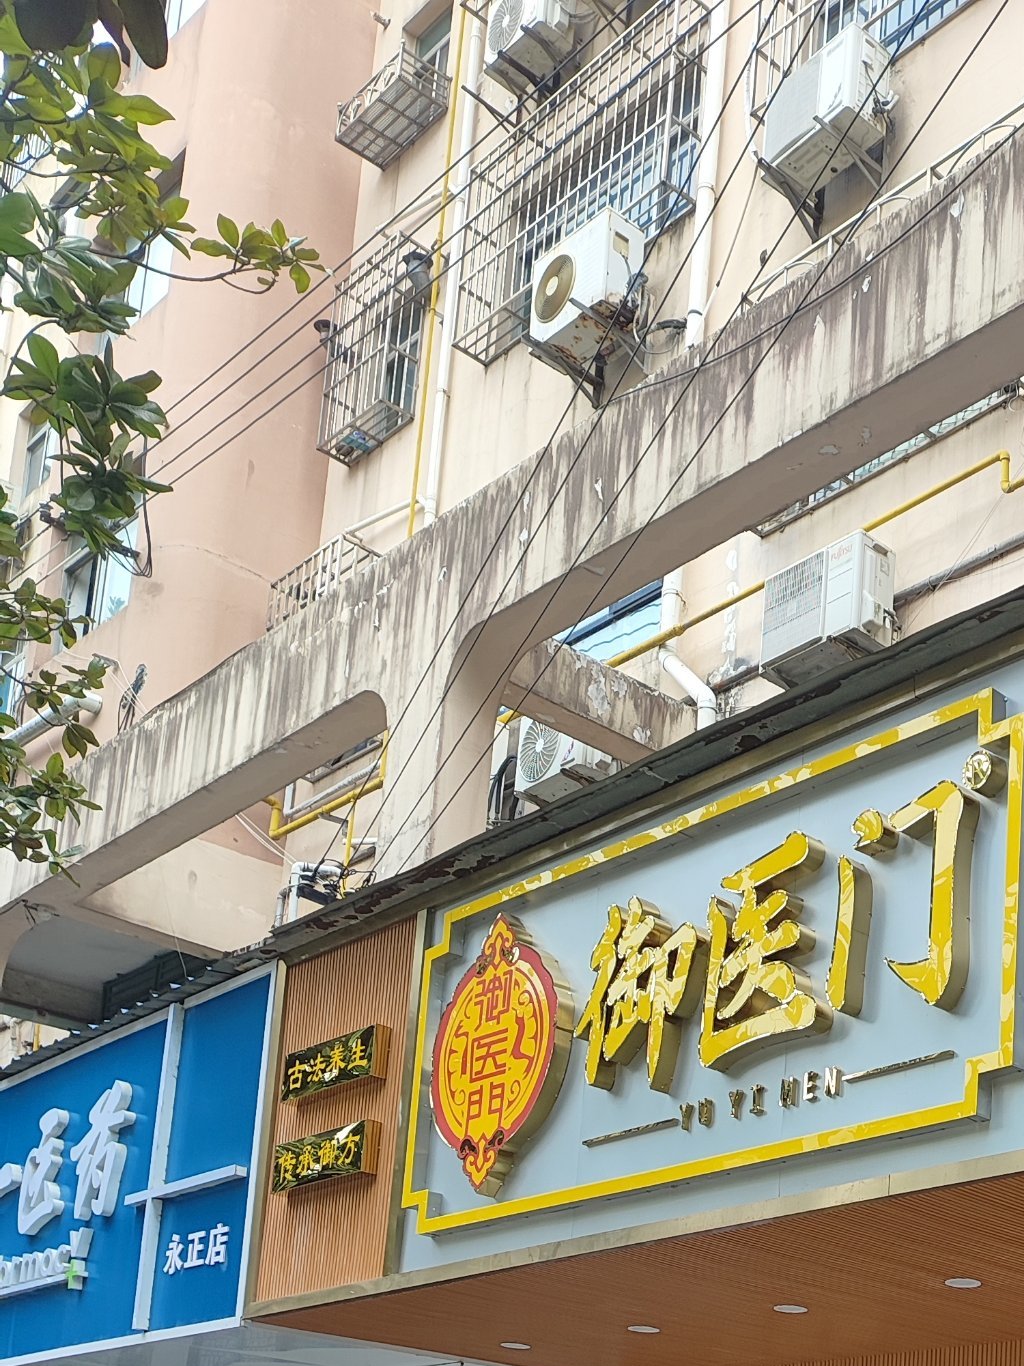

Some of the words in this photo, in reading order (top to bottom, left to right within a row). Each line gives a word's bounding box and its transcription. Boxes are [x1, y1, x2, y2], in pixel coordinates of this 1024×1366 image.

[575, 779, 966, 1092] 御医门
[288, 1039, 368, 1090] 古法养生
[680, 1098, 714, 1132] YU
[729, 1084, 766, 1119] YI
[779, 1066, 843, 1109] MEN
[278, 1133, 361, 1184] 传承御方
[163, 1223, 230, 1275] 永正店
